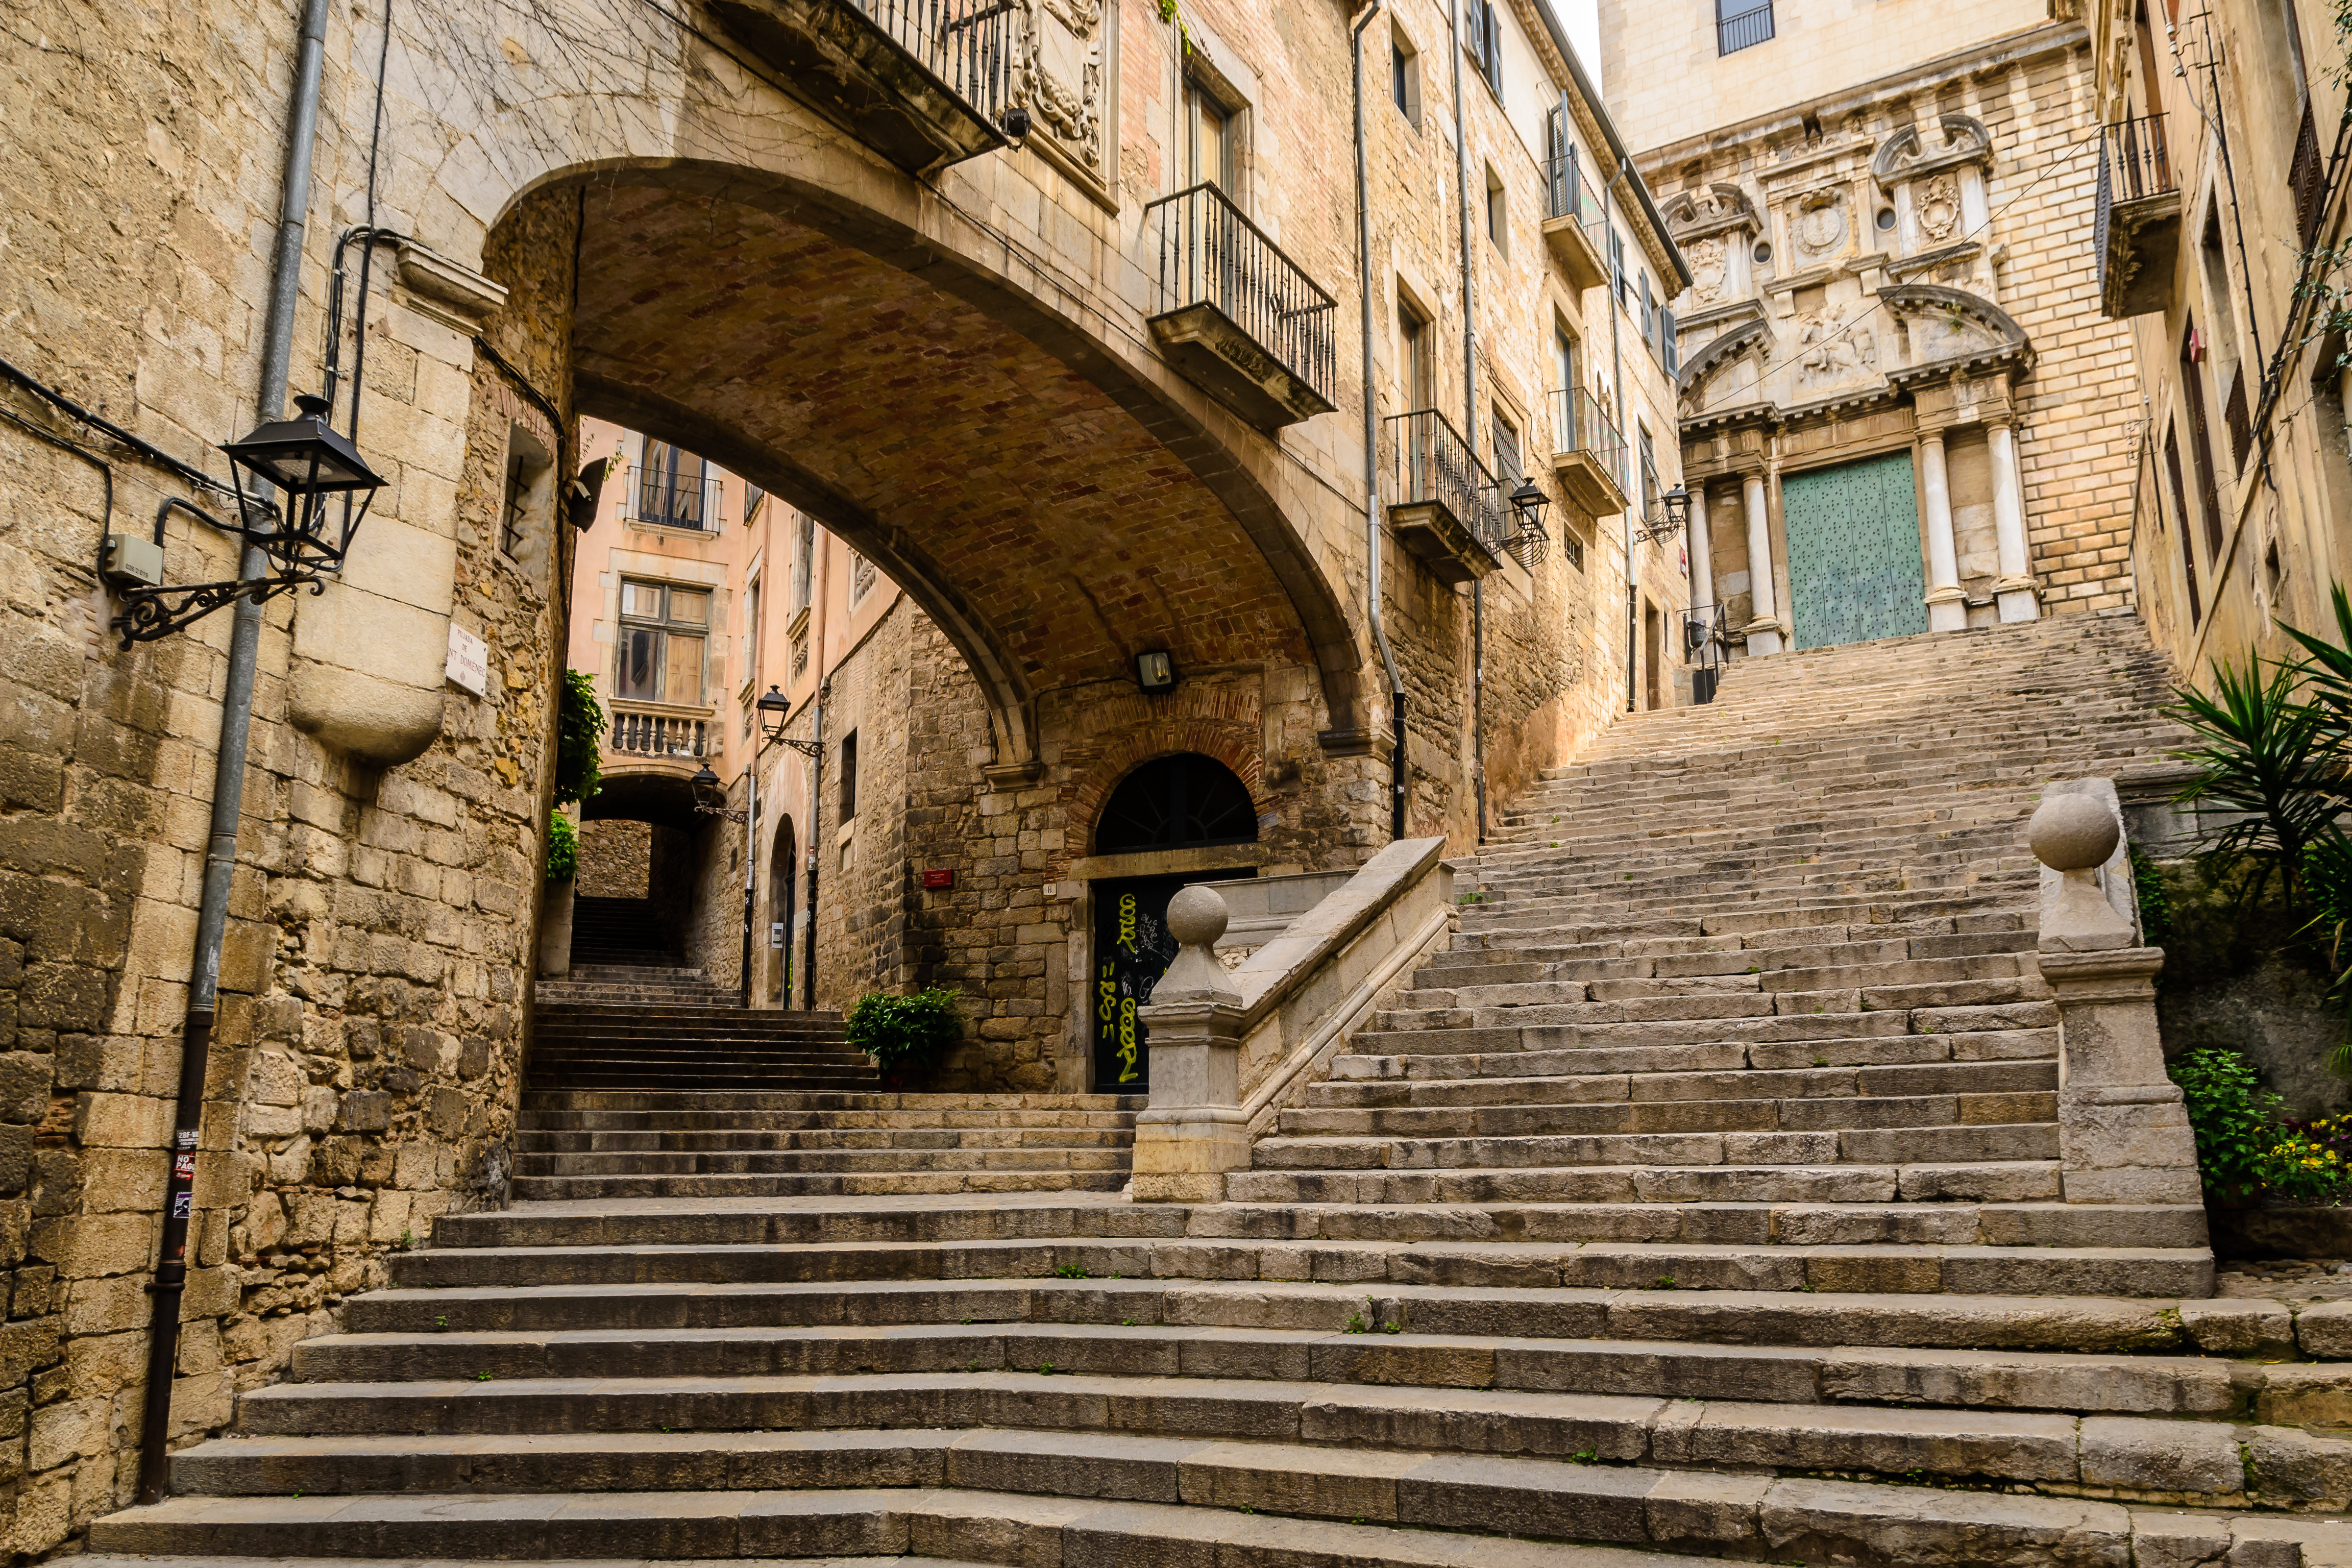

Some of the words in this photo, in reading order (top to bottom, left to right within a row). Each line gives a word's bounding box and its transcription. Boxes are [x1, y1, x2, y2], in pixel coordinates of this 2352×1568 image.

[457, 629, 473, 644] PUJADA
[448, 647, 457, 660] NT
[462, 644, 468, 652] DE
